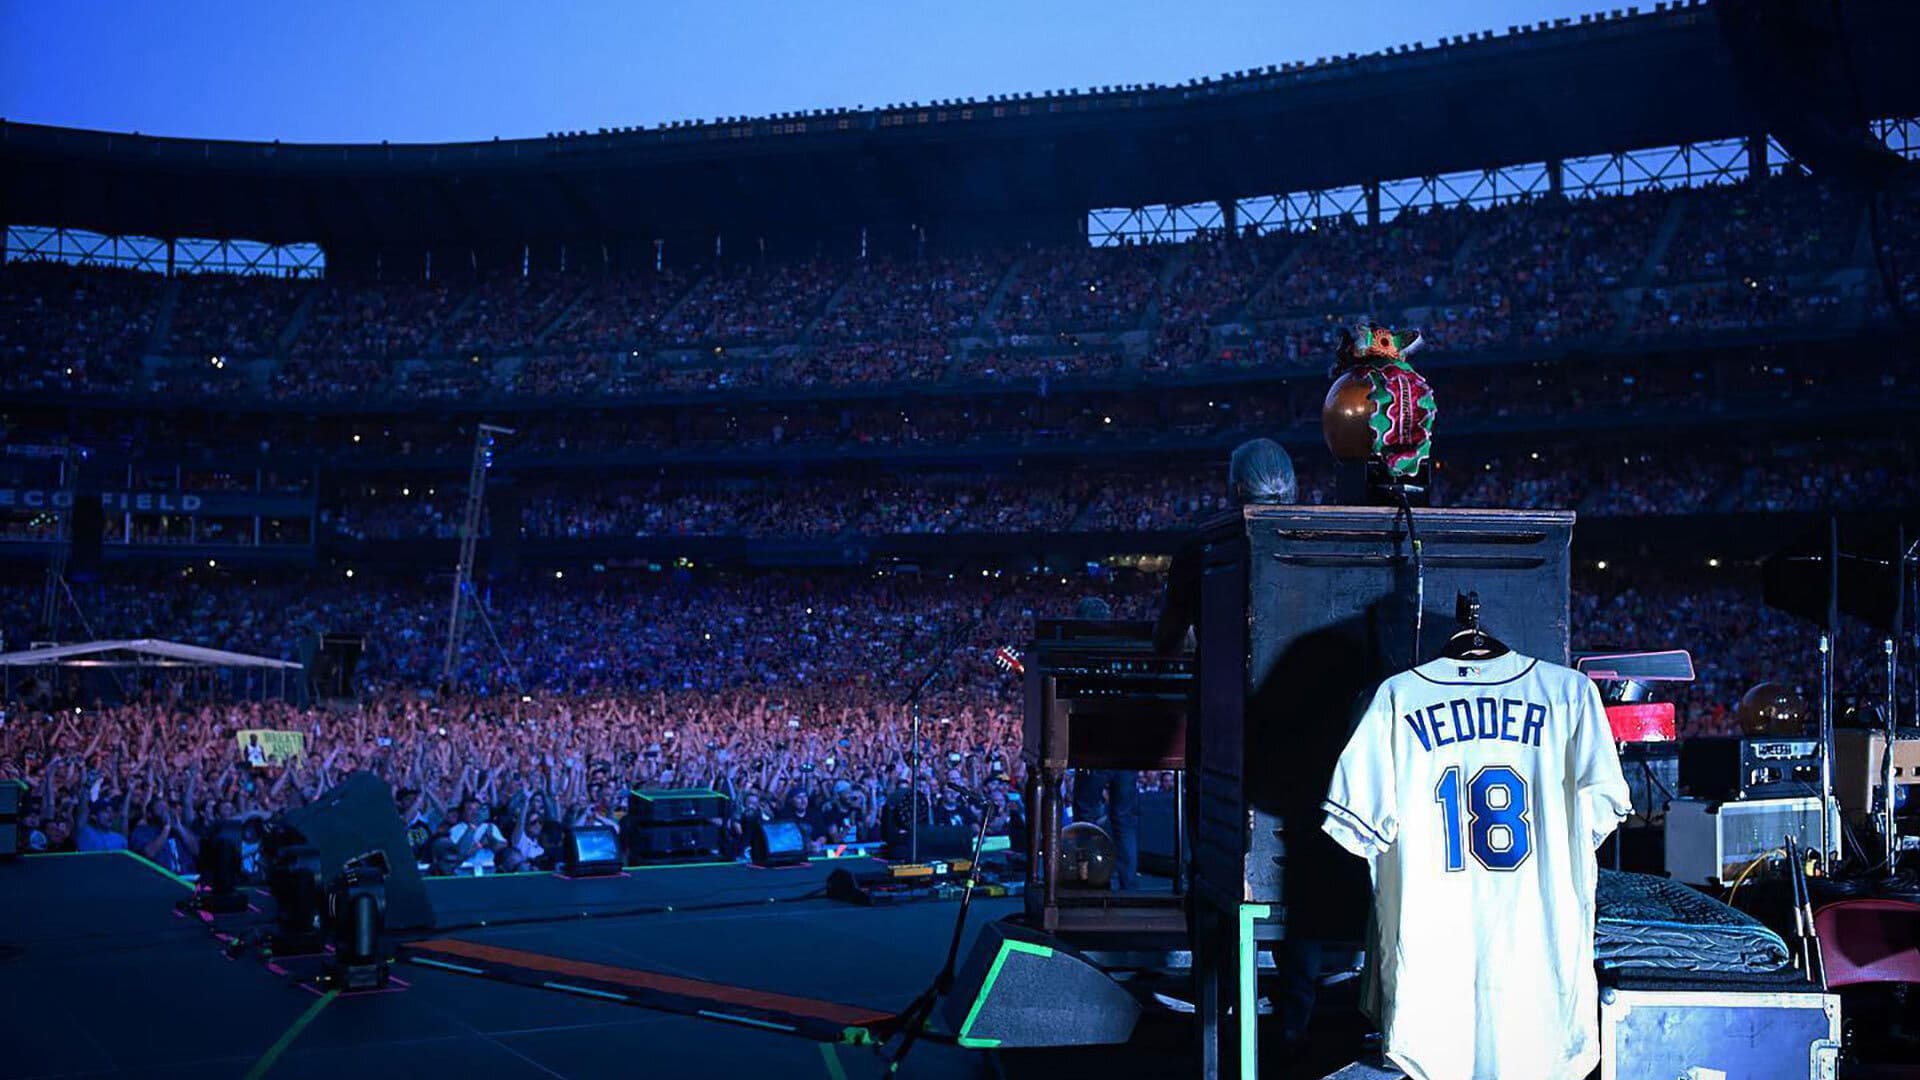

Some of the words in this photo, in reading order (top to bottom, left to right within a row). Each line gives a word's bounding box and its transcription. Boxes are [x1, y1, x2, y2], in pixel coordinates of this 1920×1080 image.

[101, 491, 202, 512] FIELD
[1404, 697, 1547, 752] VEDDER
[1434, 765, 1532, 872] 18
